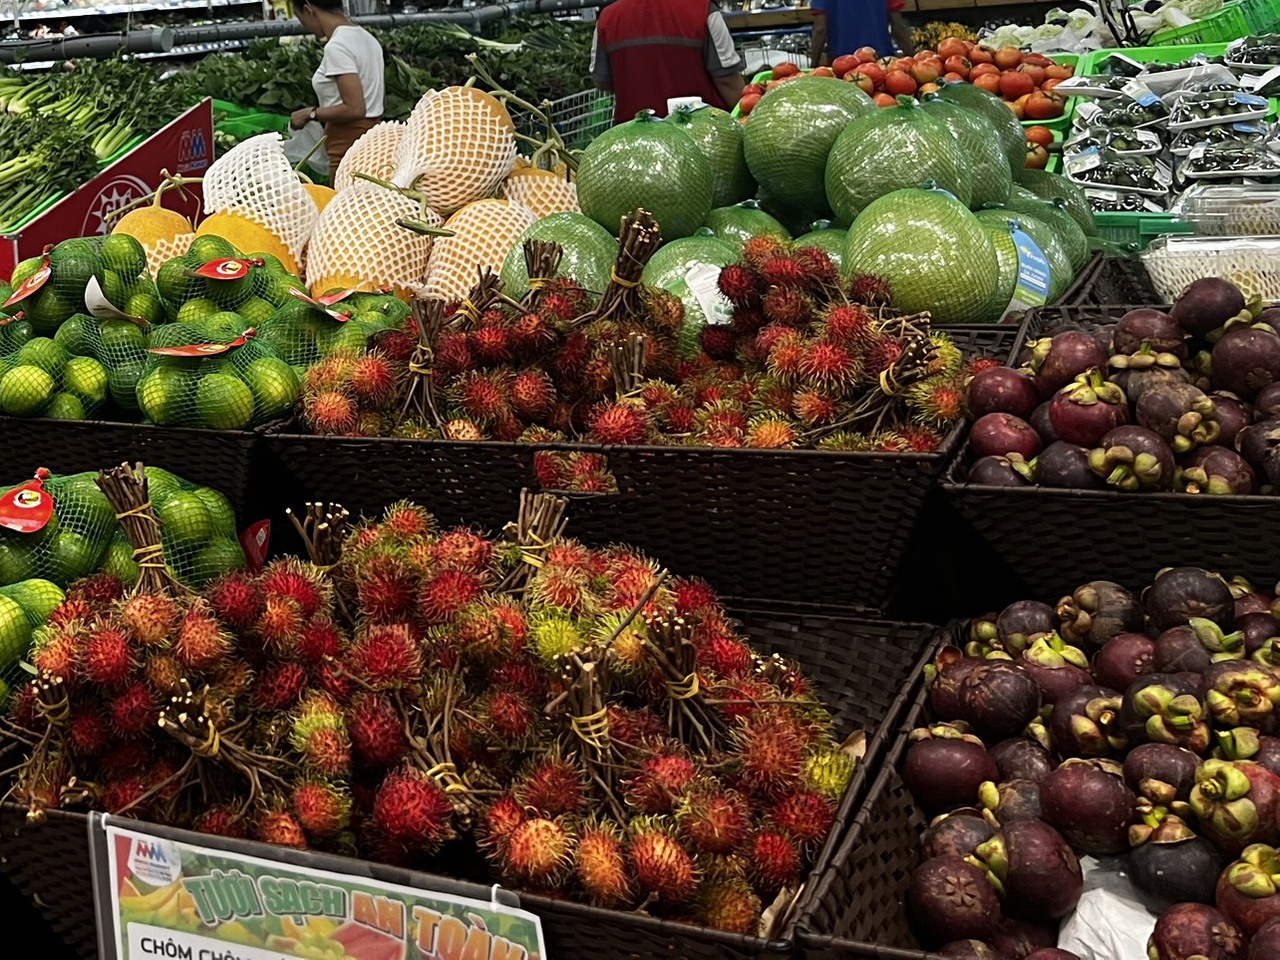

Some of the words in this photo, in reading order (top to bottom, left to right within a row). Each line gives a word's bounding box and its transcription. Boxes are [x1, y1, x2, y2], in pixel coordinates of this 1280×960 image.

[182, 868, 262, 927] TƯƠI
[259, 874, 348, 926] SẠCH
[351, 889, 405, 940] AN
[412, 906, 529, 960] TOÀN
[140, 936, 193, 960] CHÔM
